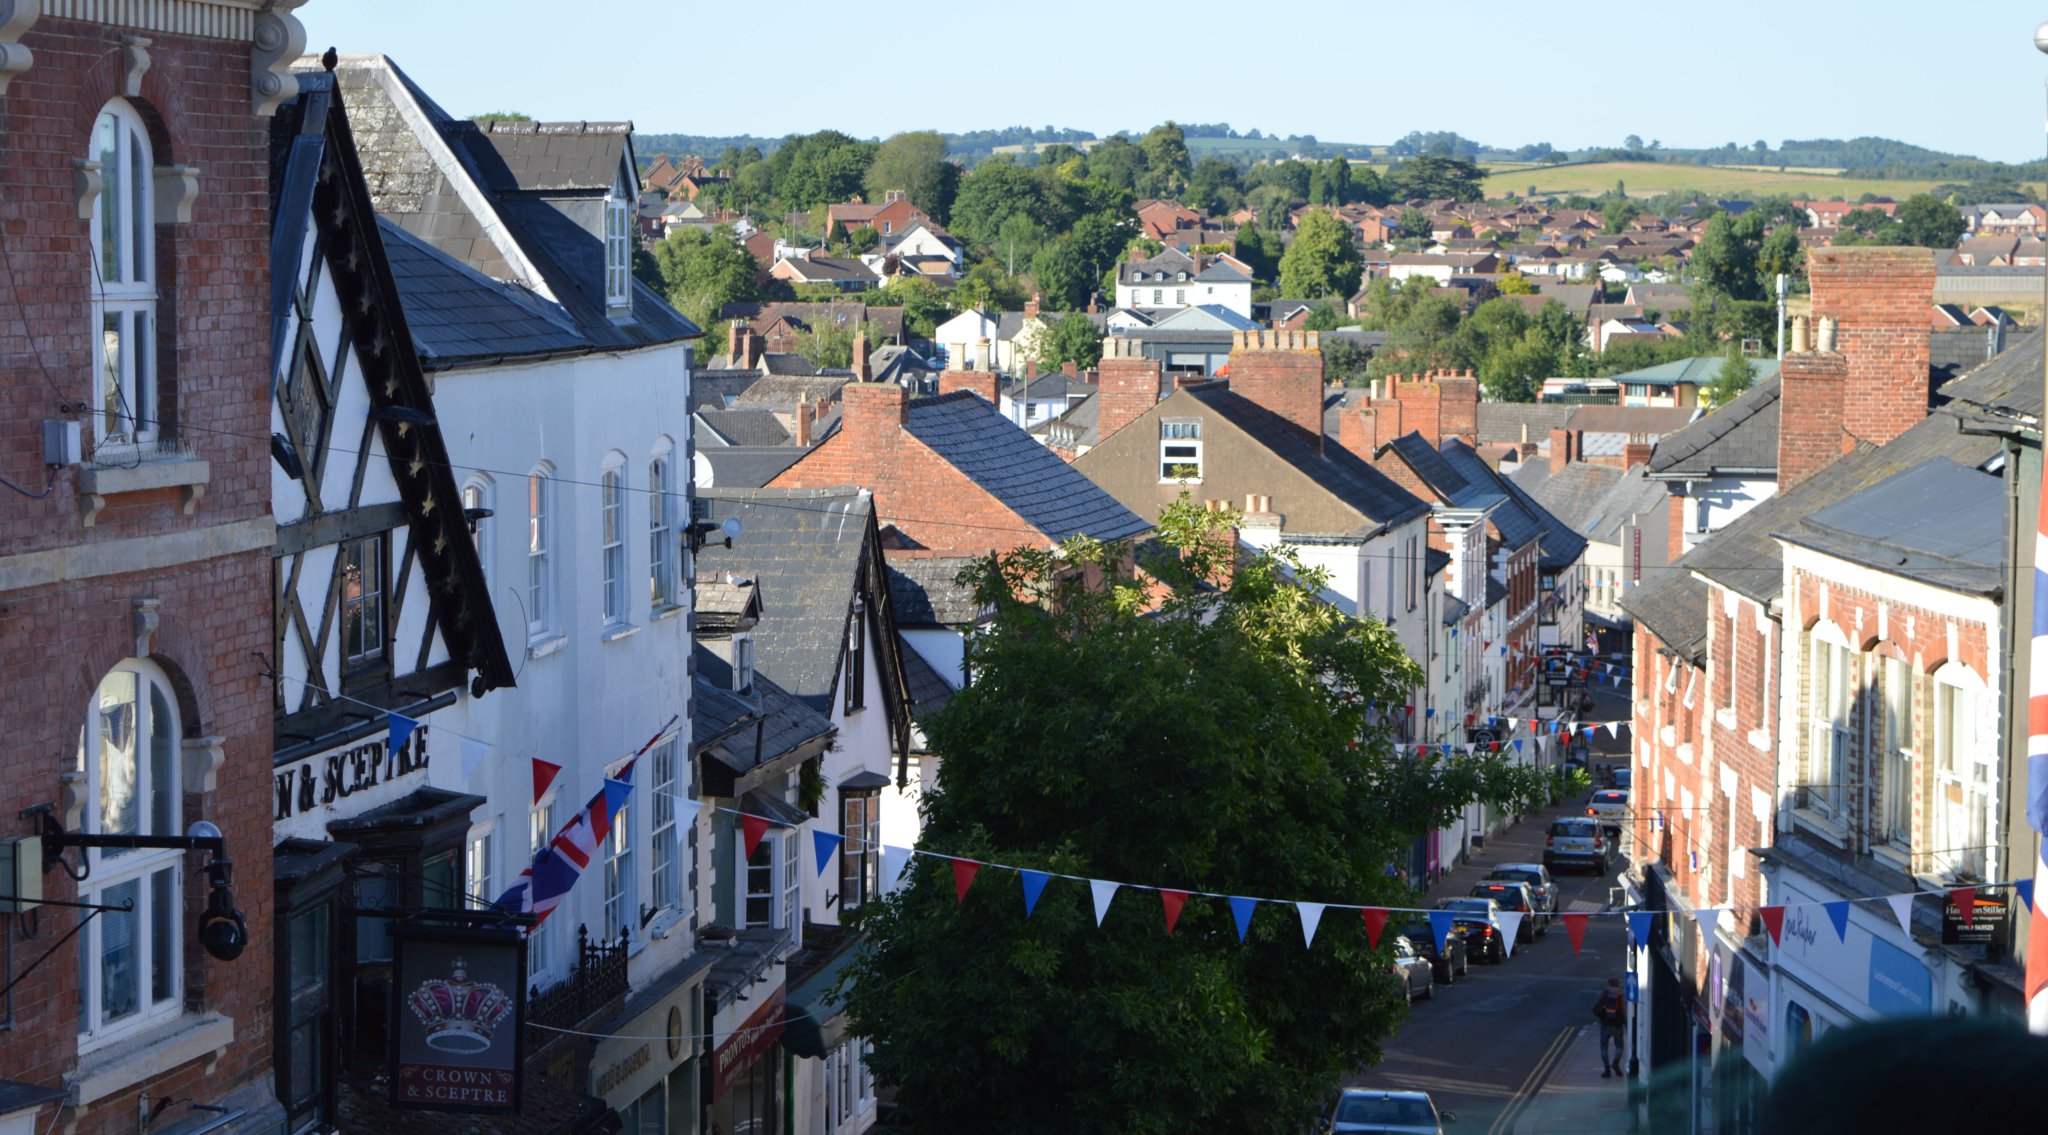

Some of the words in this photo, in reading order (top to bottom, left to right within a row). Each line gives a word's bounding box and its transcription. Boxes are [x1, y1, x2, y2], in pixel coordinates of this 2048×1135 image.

[299, 763, 317, 812] &
[1982, 905, 2007, 914] Stiller
[422, 1068, 493, 1085] CROWN
[407, 1084, 420, 1097] &
[425, 1085, 507, 1103] SCEPTRE
